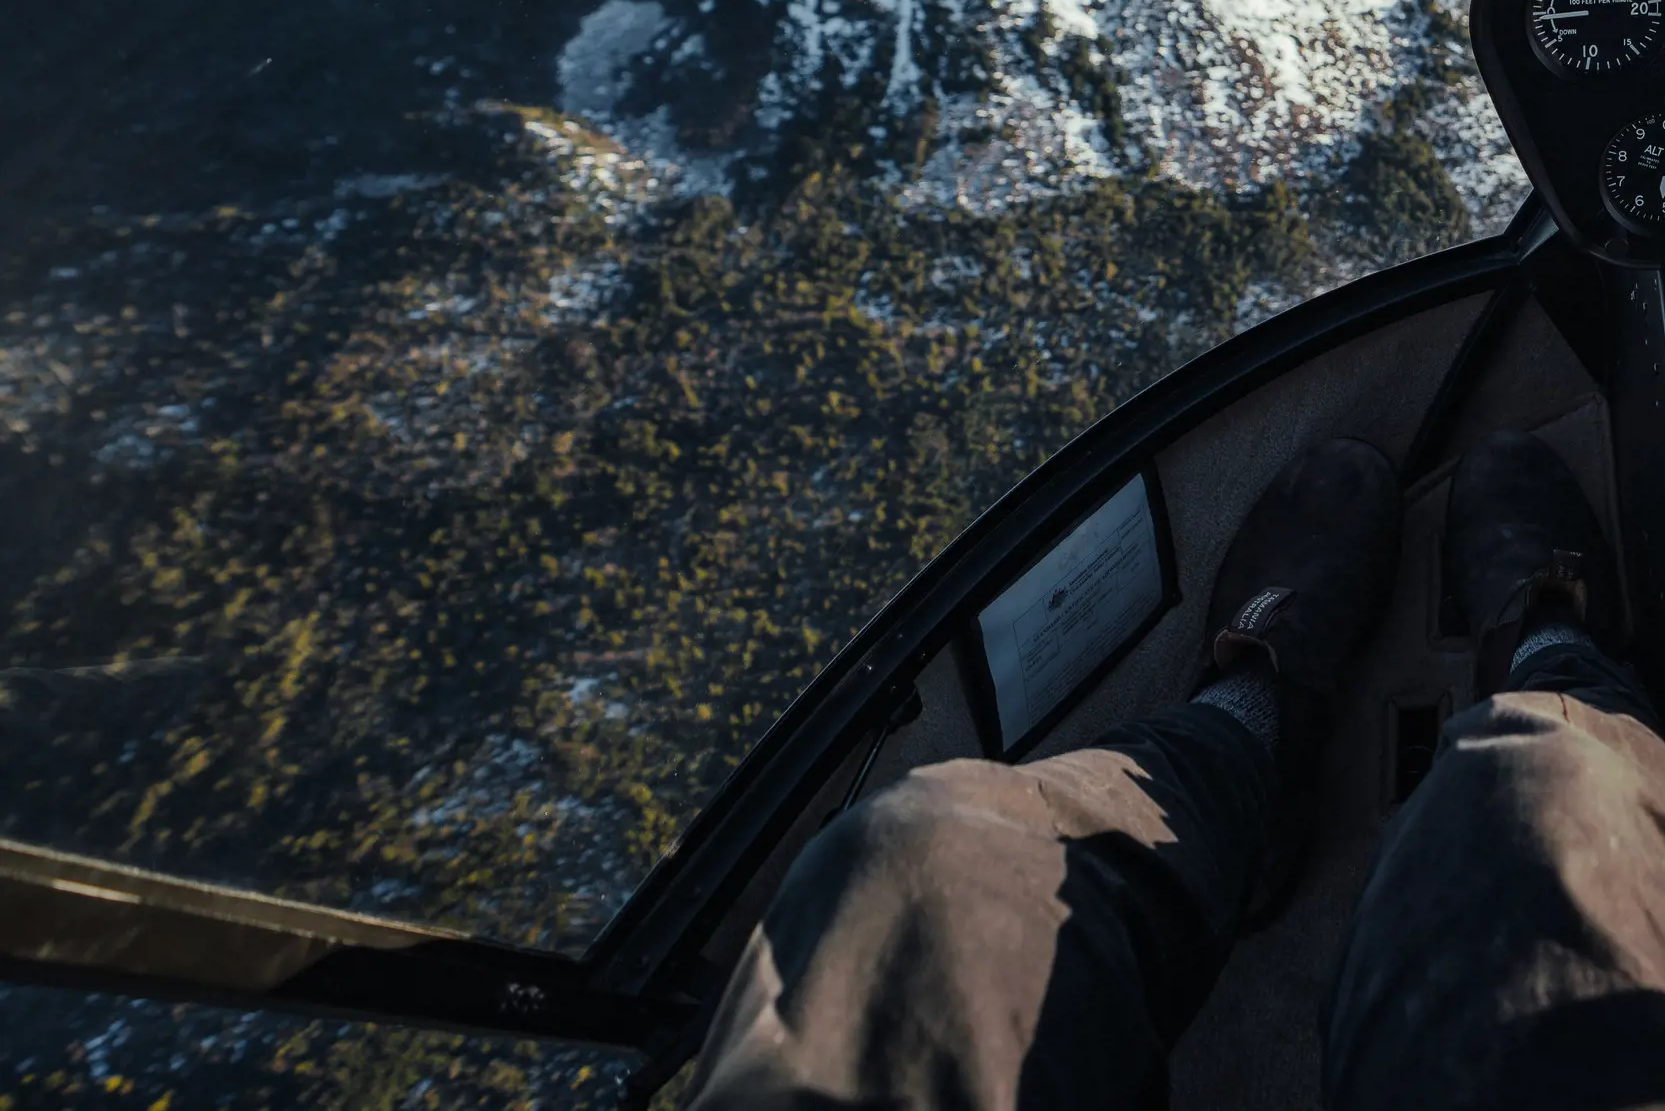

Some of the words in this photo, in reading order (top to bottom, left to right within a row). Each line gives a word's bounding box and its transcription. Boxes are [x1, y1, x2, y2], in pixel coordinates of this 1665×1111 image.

[1630, 1, 1649, 16] 20
[1558, 28, 1578, 36] DOWN
[1582, 44, 1598, 58] 10
[1618, 150, 1628, 162] 8
[1643, 144, 1665, 157] ALT
